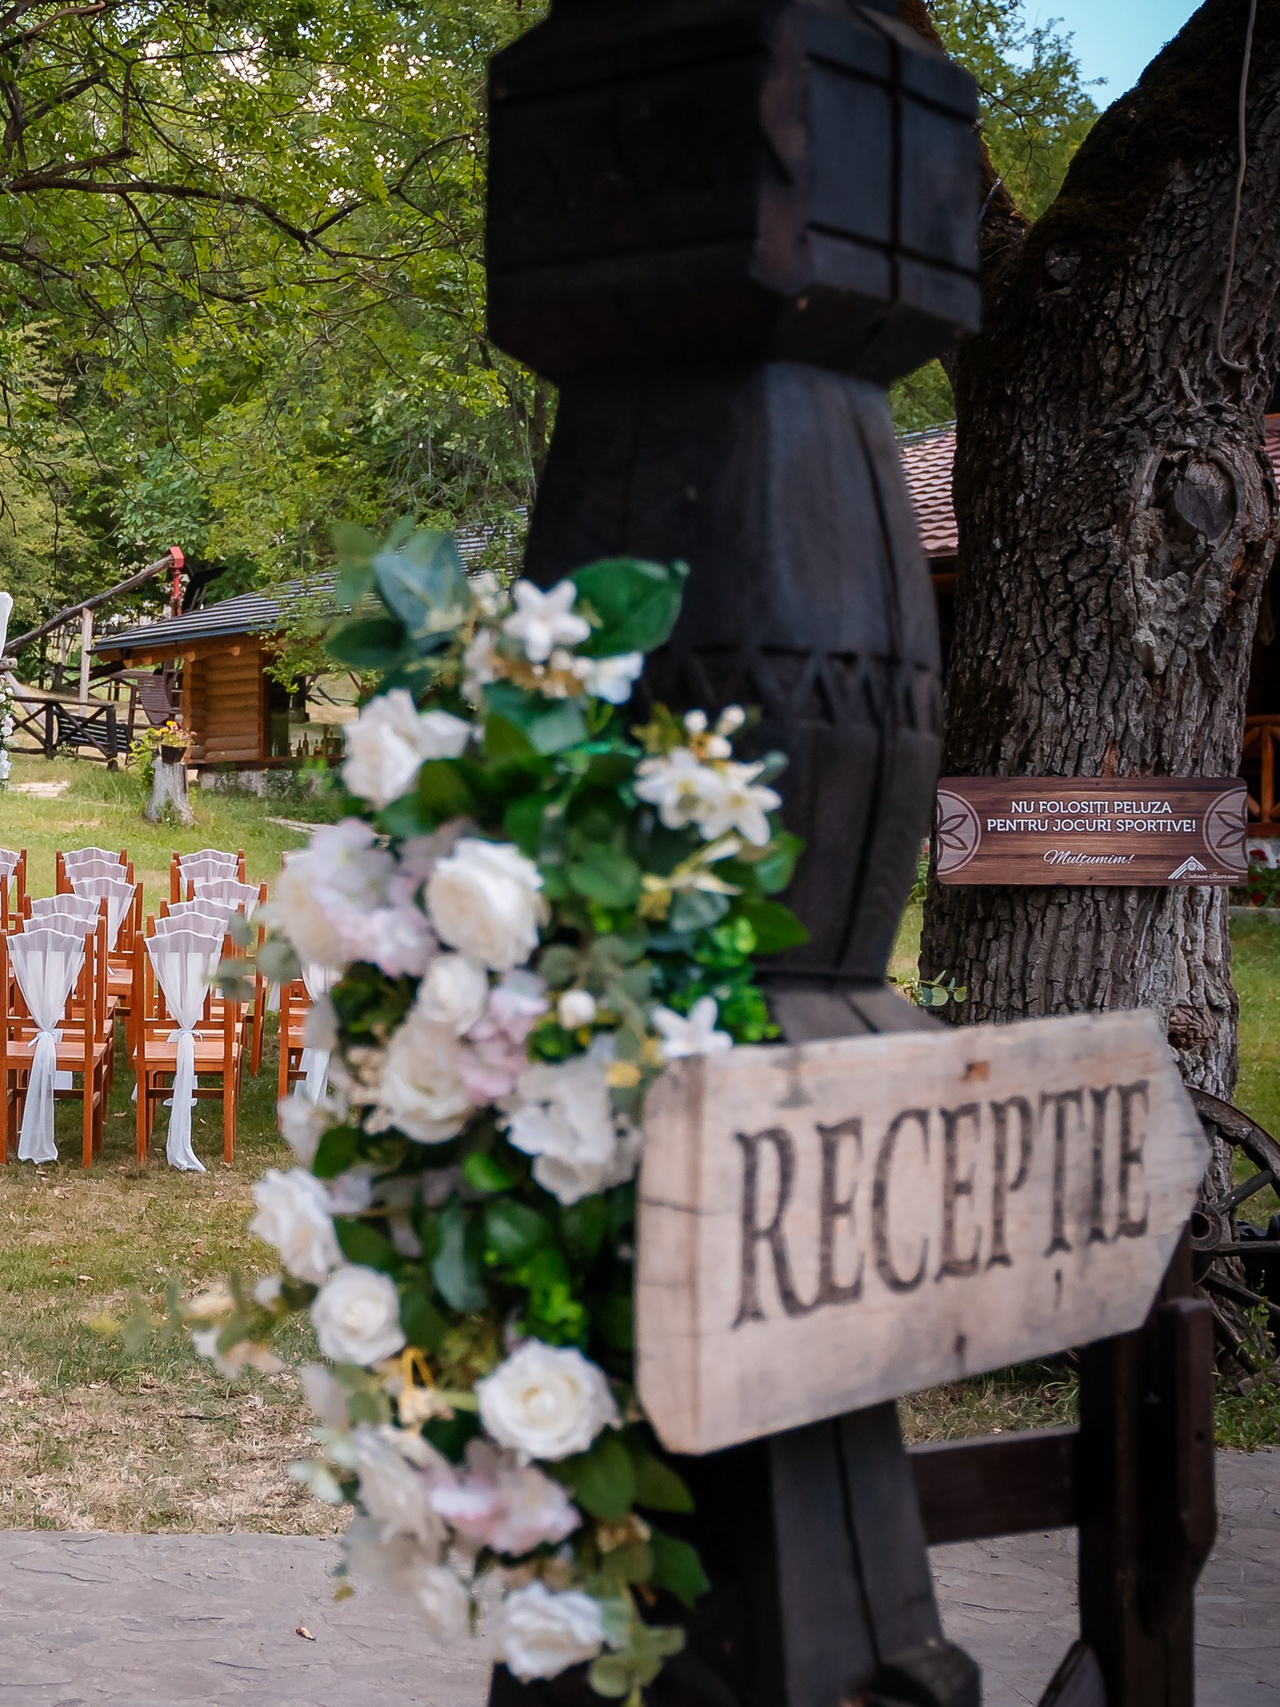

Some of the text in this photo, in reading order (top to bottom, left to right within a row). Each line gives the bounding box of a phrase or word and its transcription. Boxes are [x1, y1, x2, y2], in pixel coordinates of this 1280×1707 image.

[1010, 801, 1035, 813] NU
[1113, 801, 1173, 814] PELUZA
[986, 819, 1196, 832] PENTRU JOCURI SPORTIVE!
